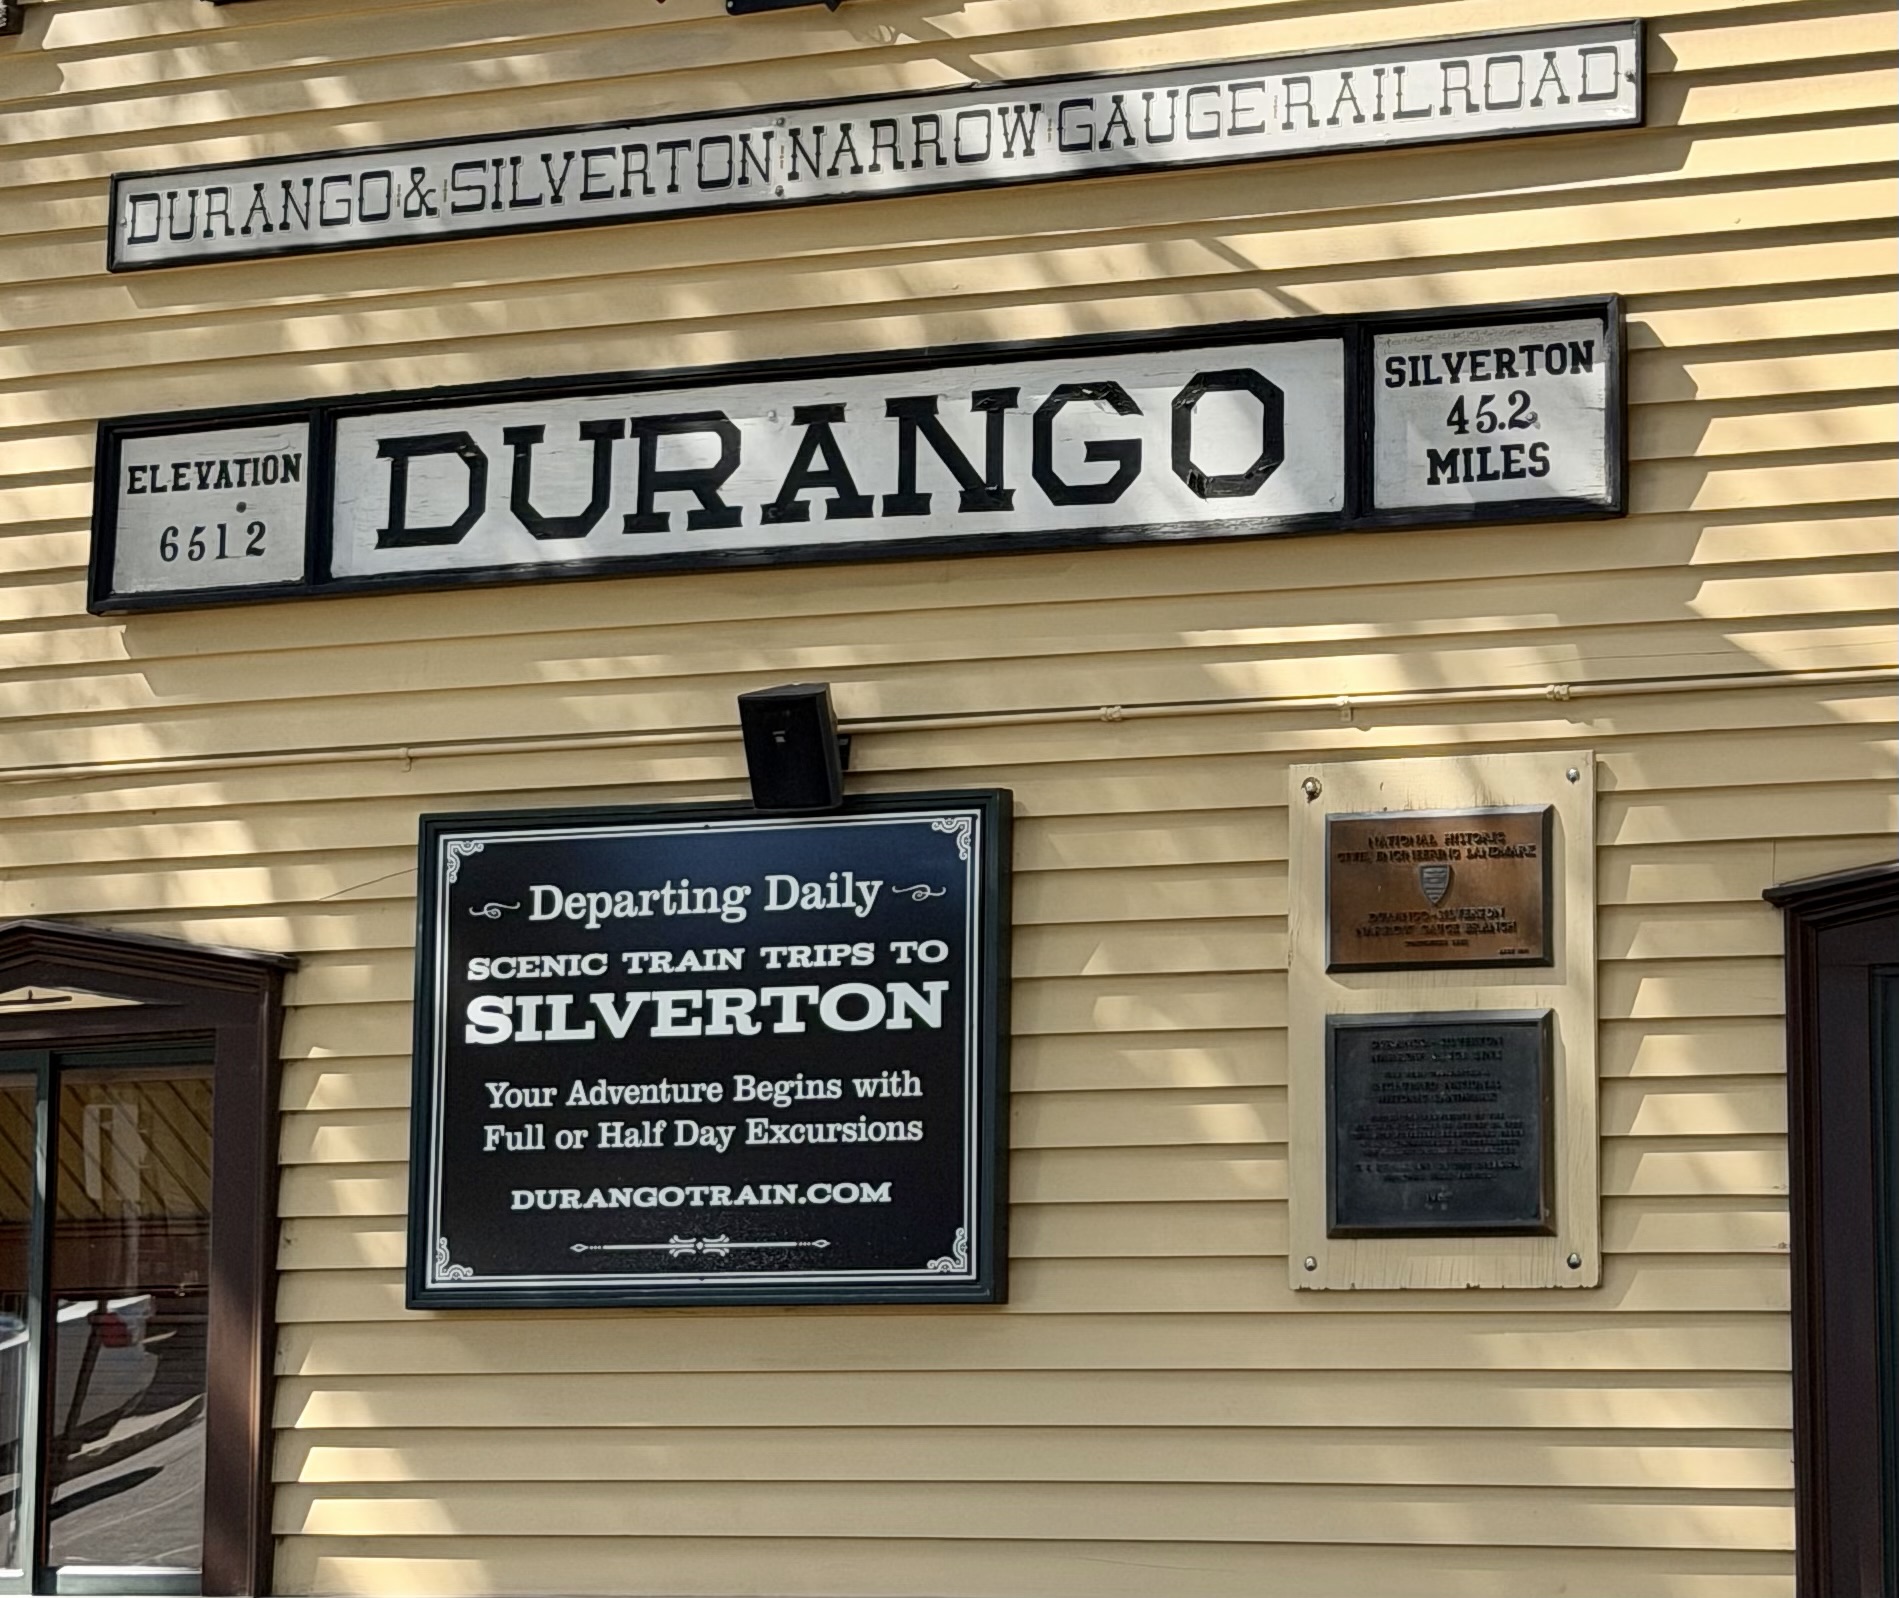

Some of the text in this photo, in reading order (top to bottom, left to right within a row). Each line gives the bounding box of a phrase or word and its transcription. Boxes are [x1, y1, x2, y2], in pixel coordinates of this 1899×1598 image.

[126, 45, 1620, 245] DURANGO & SILVERTON NARROW GAUGE RAILROAD
[1385, 340, 1595, 388] SILVERTON
[1447, 390, 1535, 434] 45.2
[127, 453, 301, 494] ELEVATION
[375, 368, 1285, 551] DURANGO
[1426, 442, 1550, 485] MILES
[160, 521, 266, 562] 6512
[529, 872, 883, 929] Departing Daily
[468, 940, 948, 980] SCENIC TRAIN TRIPS TO
[465, 981, 949, 1044] SILVERTON
[485, 1070, 923, 1108] Your Adventure Begins with
[484, 1115, 923, 1153] Full or Half Day Excursions
[511, 1182, 892, 1209] DURANGOTRAIN.COM
